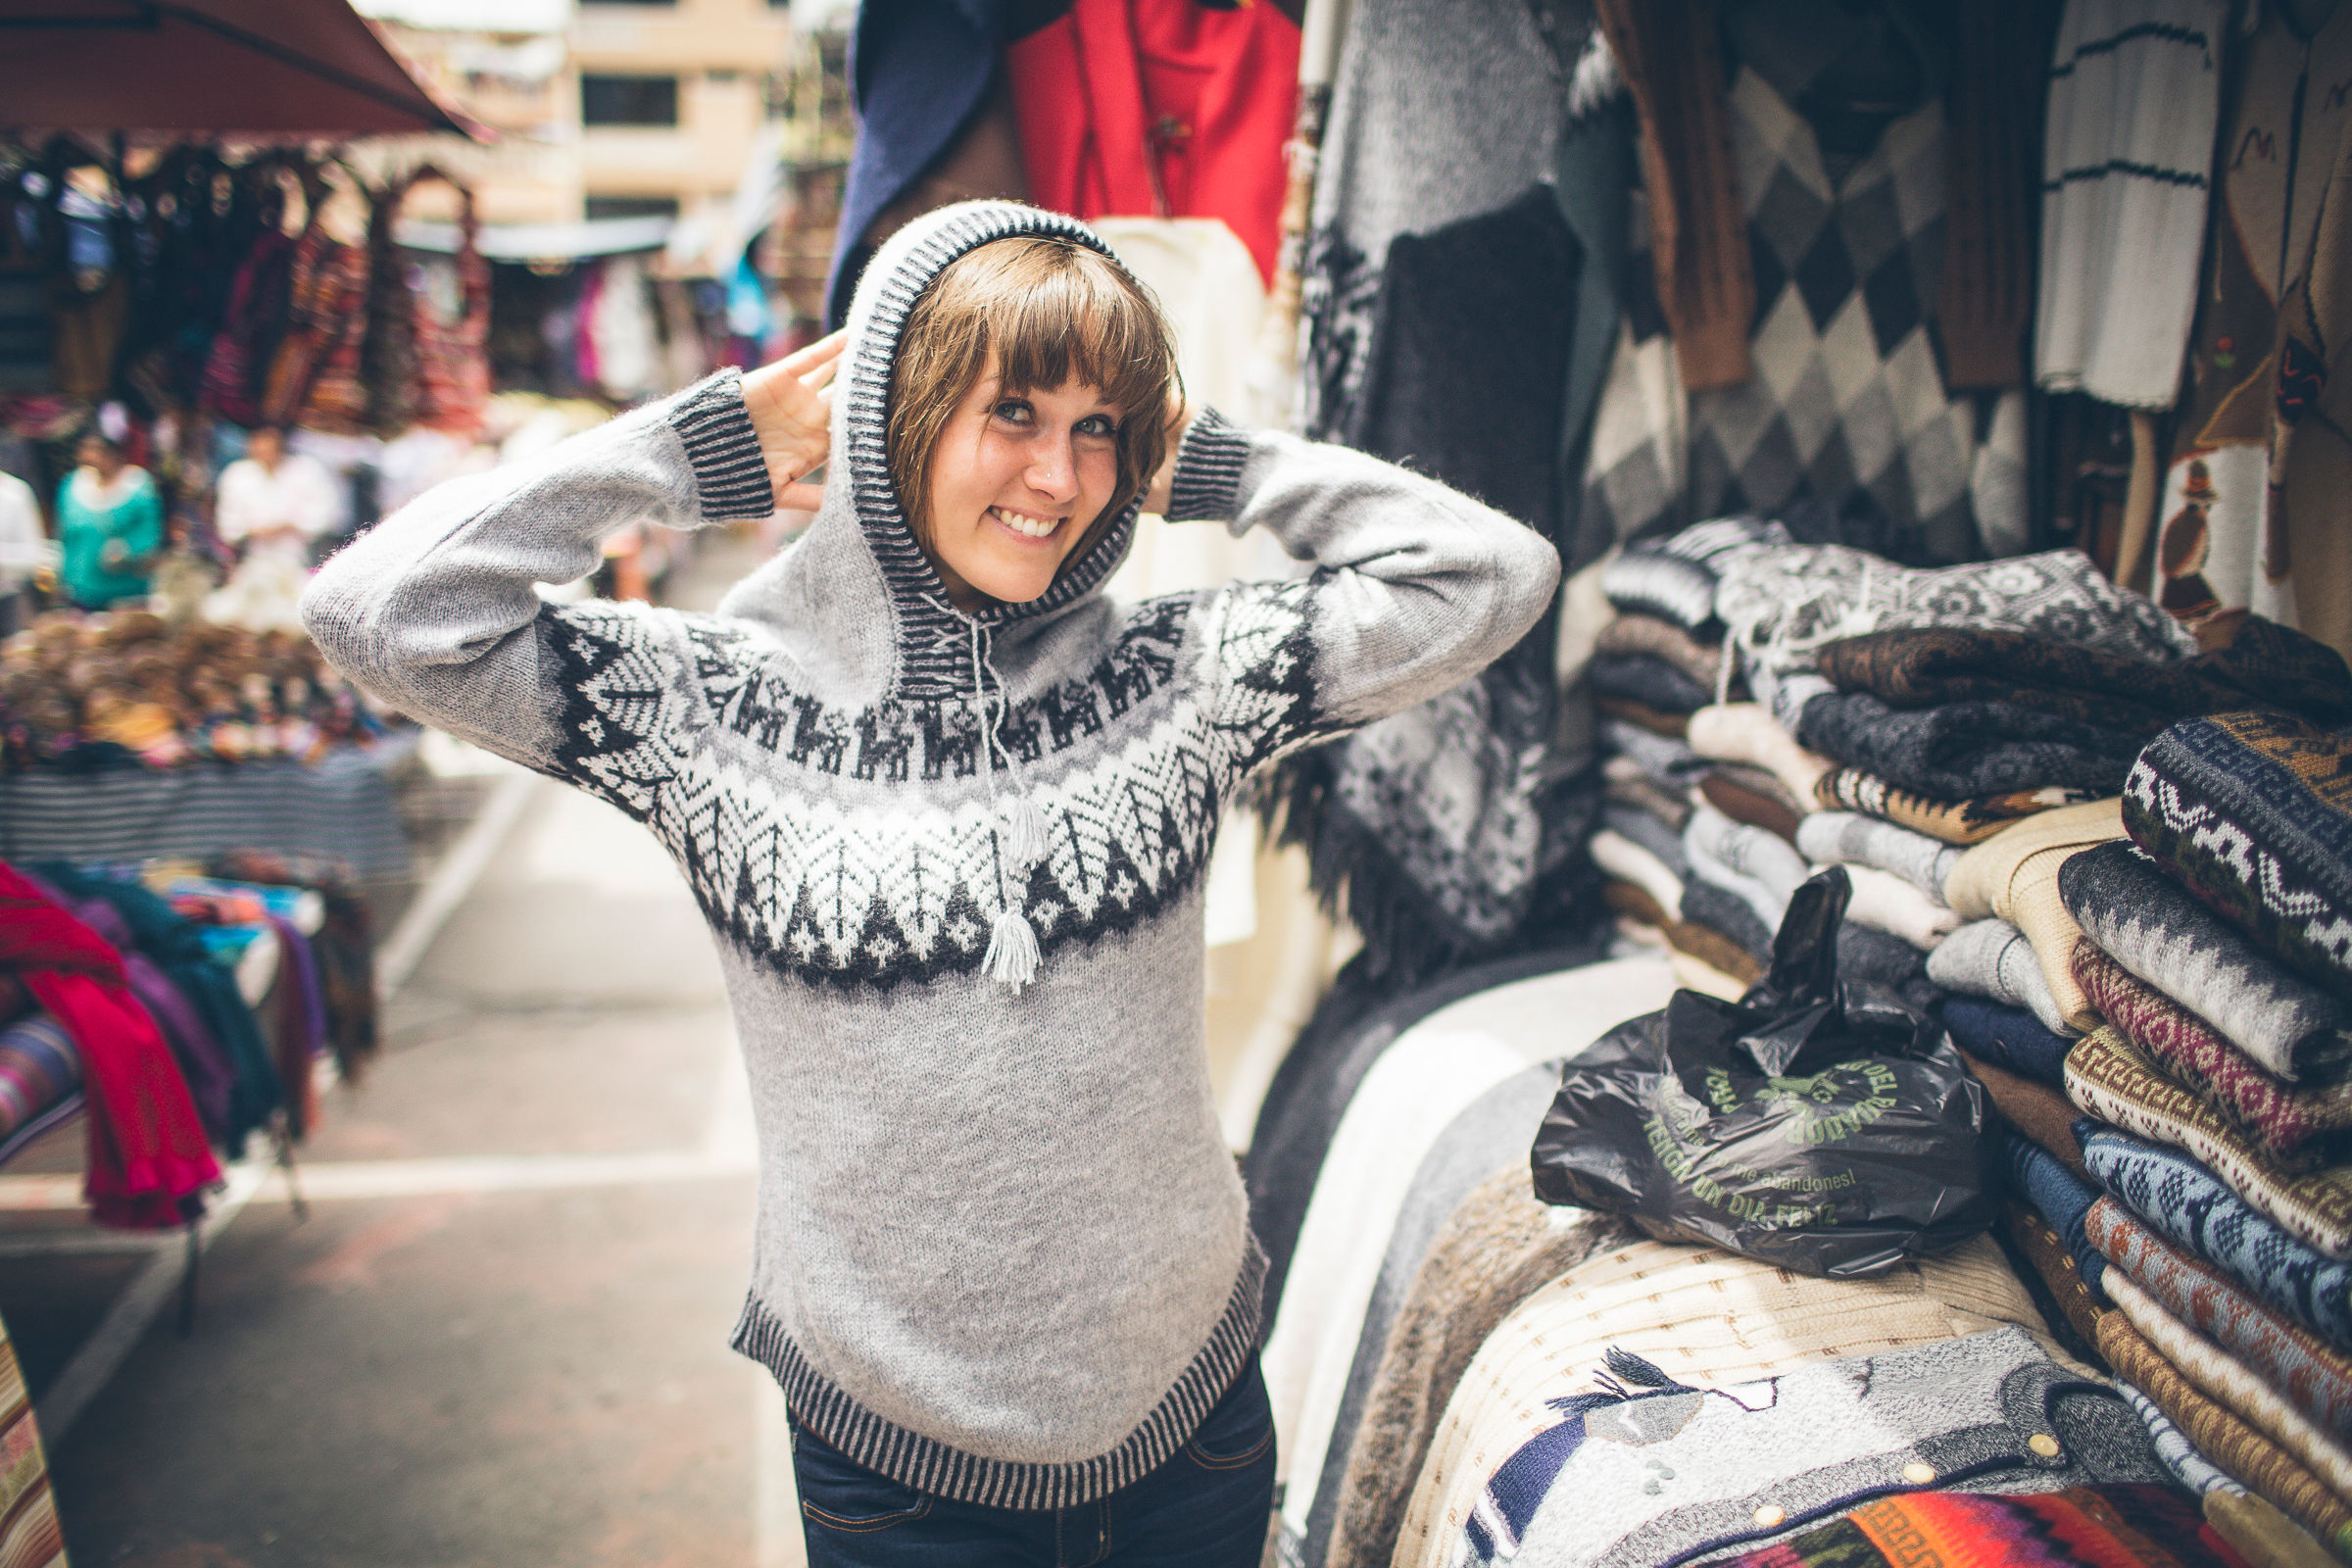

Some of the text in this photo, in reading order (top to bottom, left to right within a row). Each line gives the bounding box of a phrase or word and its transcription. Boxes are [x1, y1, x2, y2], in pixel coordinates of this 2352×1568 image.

[1863, 1063, 1898, 1096] DEL
[1642, 1113, 1693, 1185] TENGA
[1691, 1174, 1727, 1208] UN
[1776, 1203, 1838, 1228] FELIZ
[1761, 1168, 1857, 1193] abandones!
